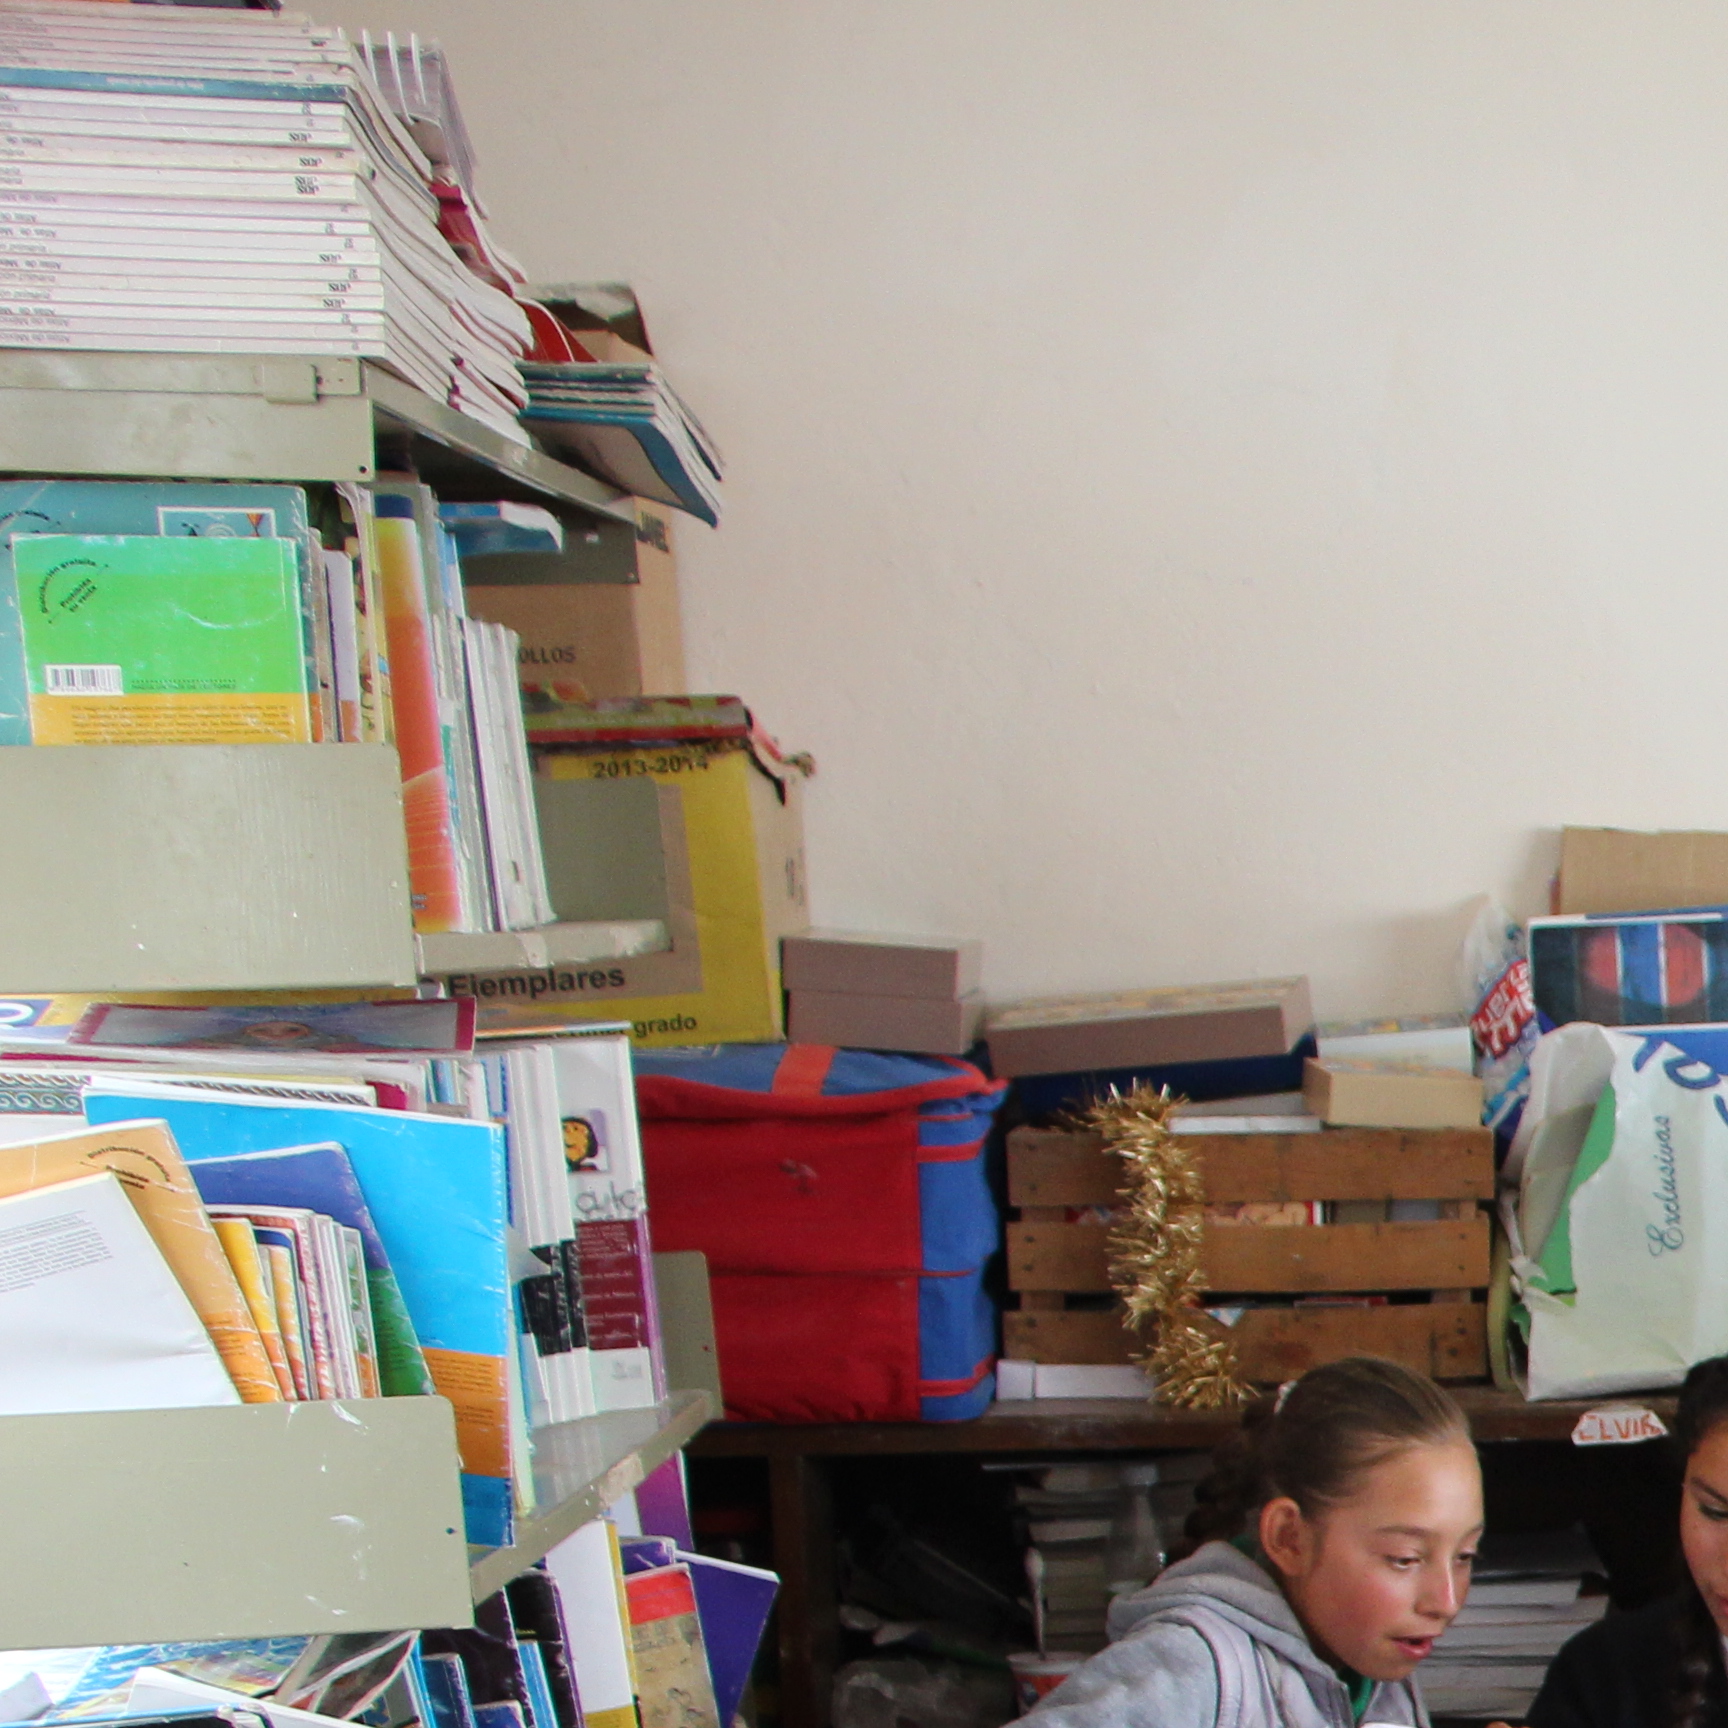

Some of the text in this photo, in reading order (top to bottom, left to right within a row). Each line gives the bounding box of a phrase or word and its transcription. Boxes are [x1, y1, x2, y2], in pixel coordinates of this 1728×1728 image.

[519, 646, 576, 664] OLLOS
[592, 754, 709, 779] 2013-2014
[450, 966, 626, 999] Ejemplares
[633, 1013, 697, 1039] grado
[1646, 1115, 1684, 1256] Exclusivas
